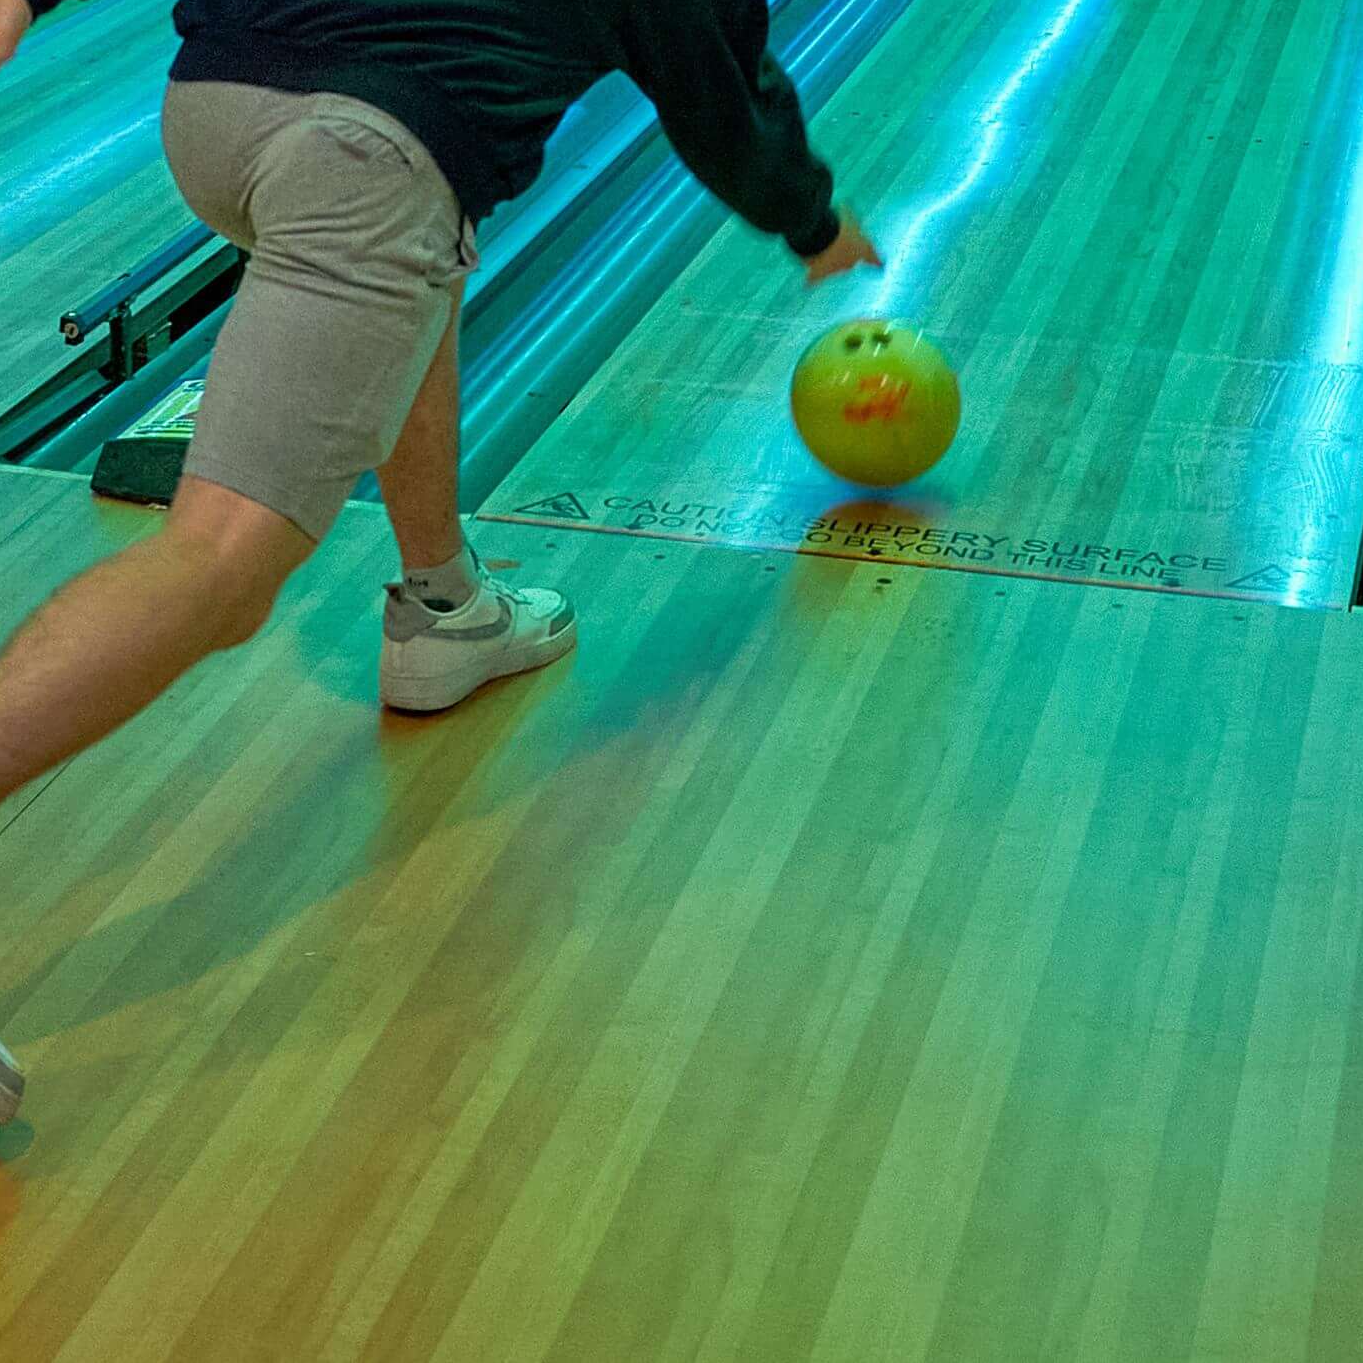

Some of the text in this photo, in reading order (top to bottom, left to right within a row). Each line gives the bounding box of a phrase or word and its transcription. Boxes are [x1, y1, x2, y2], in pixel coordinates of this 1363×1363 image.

[604, 496, 1227, 572] CAUTION SLIPPERY SURFACE
[633, 514, 685, 528] DO
[781, 529, 832, 544] GO
[843, 535, 995, 561] BEYOND
[1010, 553, 1085, 571] THIS
[1099, 562, 1180, 580] LINE
